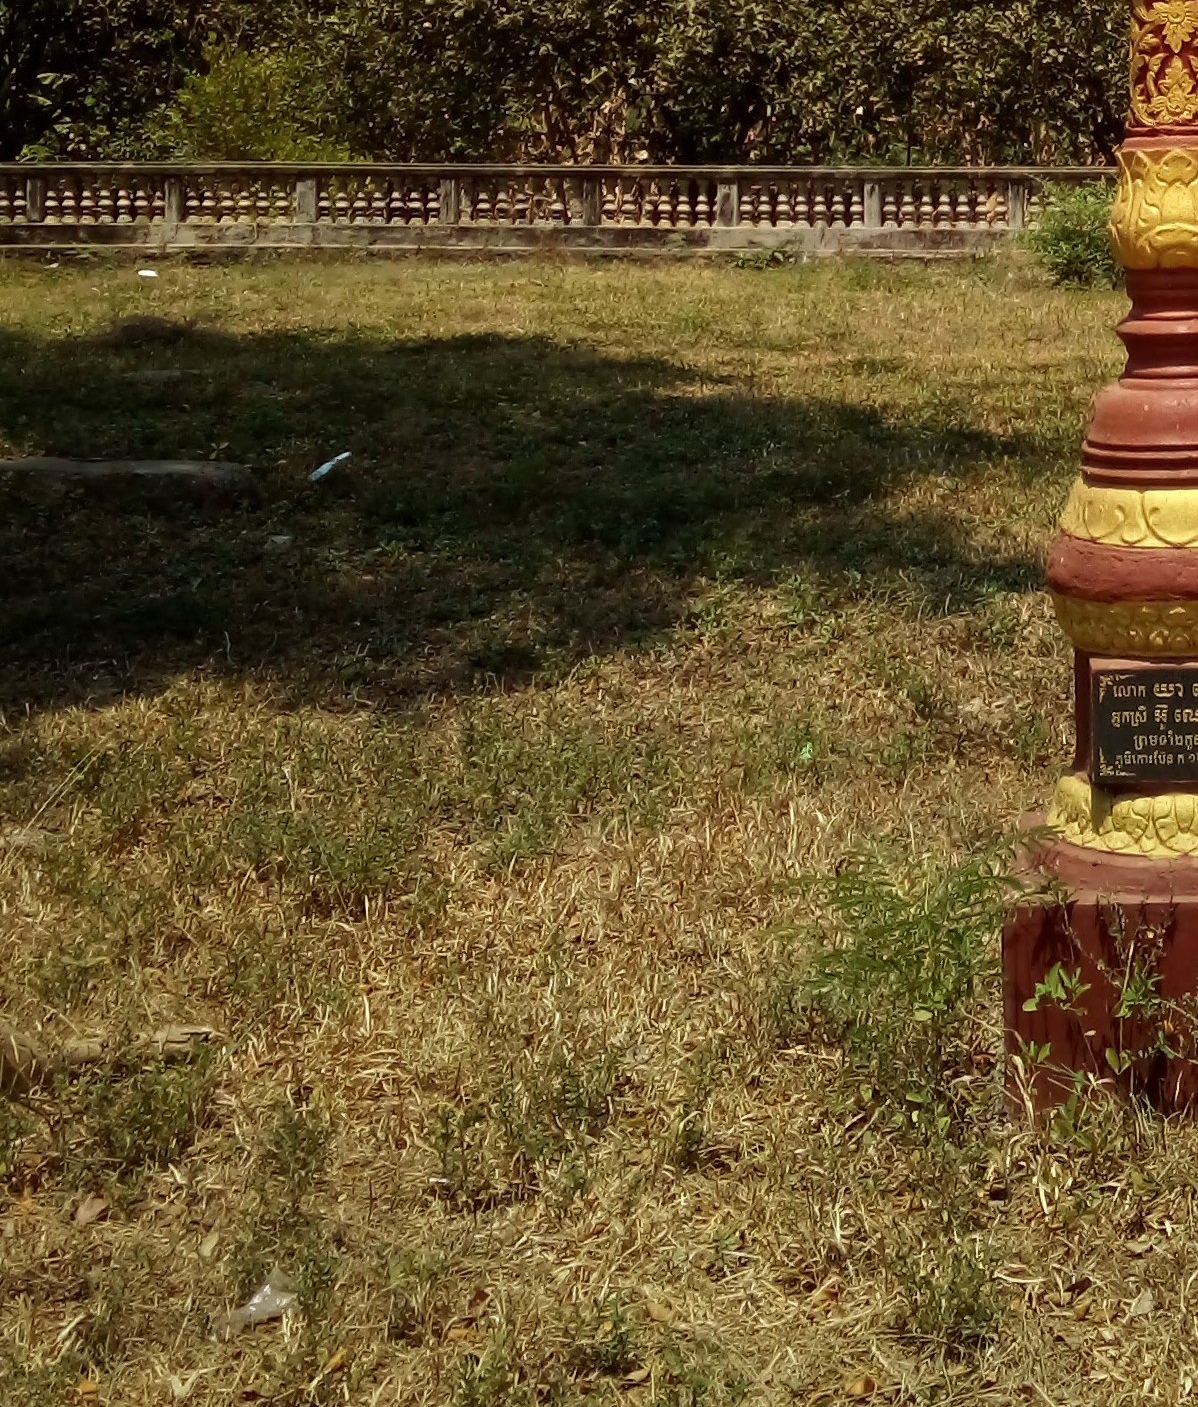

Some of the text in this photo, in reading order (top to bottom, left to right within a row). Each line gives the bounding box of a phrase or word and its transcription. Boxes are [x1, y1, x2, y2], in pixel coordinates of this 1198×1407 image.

[1113, 684, 1146, 697] លោក
[1111, 705, 1147, 727] អ្នកស្រី
